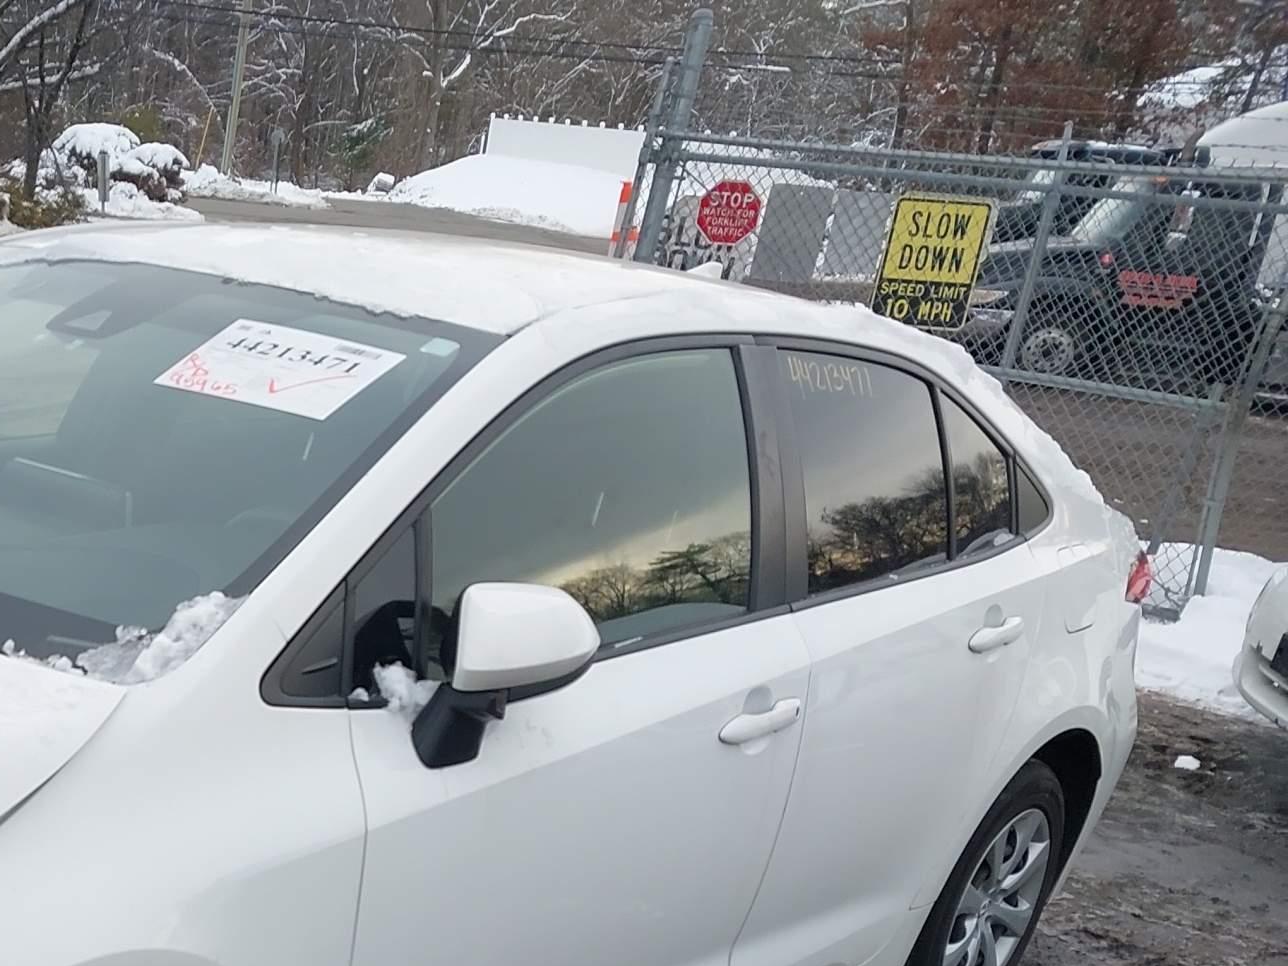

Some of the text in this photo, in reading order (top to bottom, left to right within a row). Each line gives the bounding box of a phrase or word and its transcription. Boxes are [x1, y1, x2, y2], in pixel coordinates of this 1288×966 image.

[709, 190, 755, 208] STOP
[703, 206, 755, 219] WATCH FOR
[706, 216, 749, 227] FORKLIFT
[707, 226, 744, 237] TRAFFIC
[908, 210, 972, 241] SLOW
[898, 244, 965, 274] DOWN
[880, 281, 968, 300] SPEED LIMIT
[886, 299, 953, 322] 10 MPH
[227, 337, 361, 374] 44213471
[787, 356, 873, 400] 44213471
